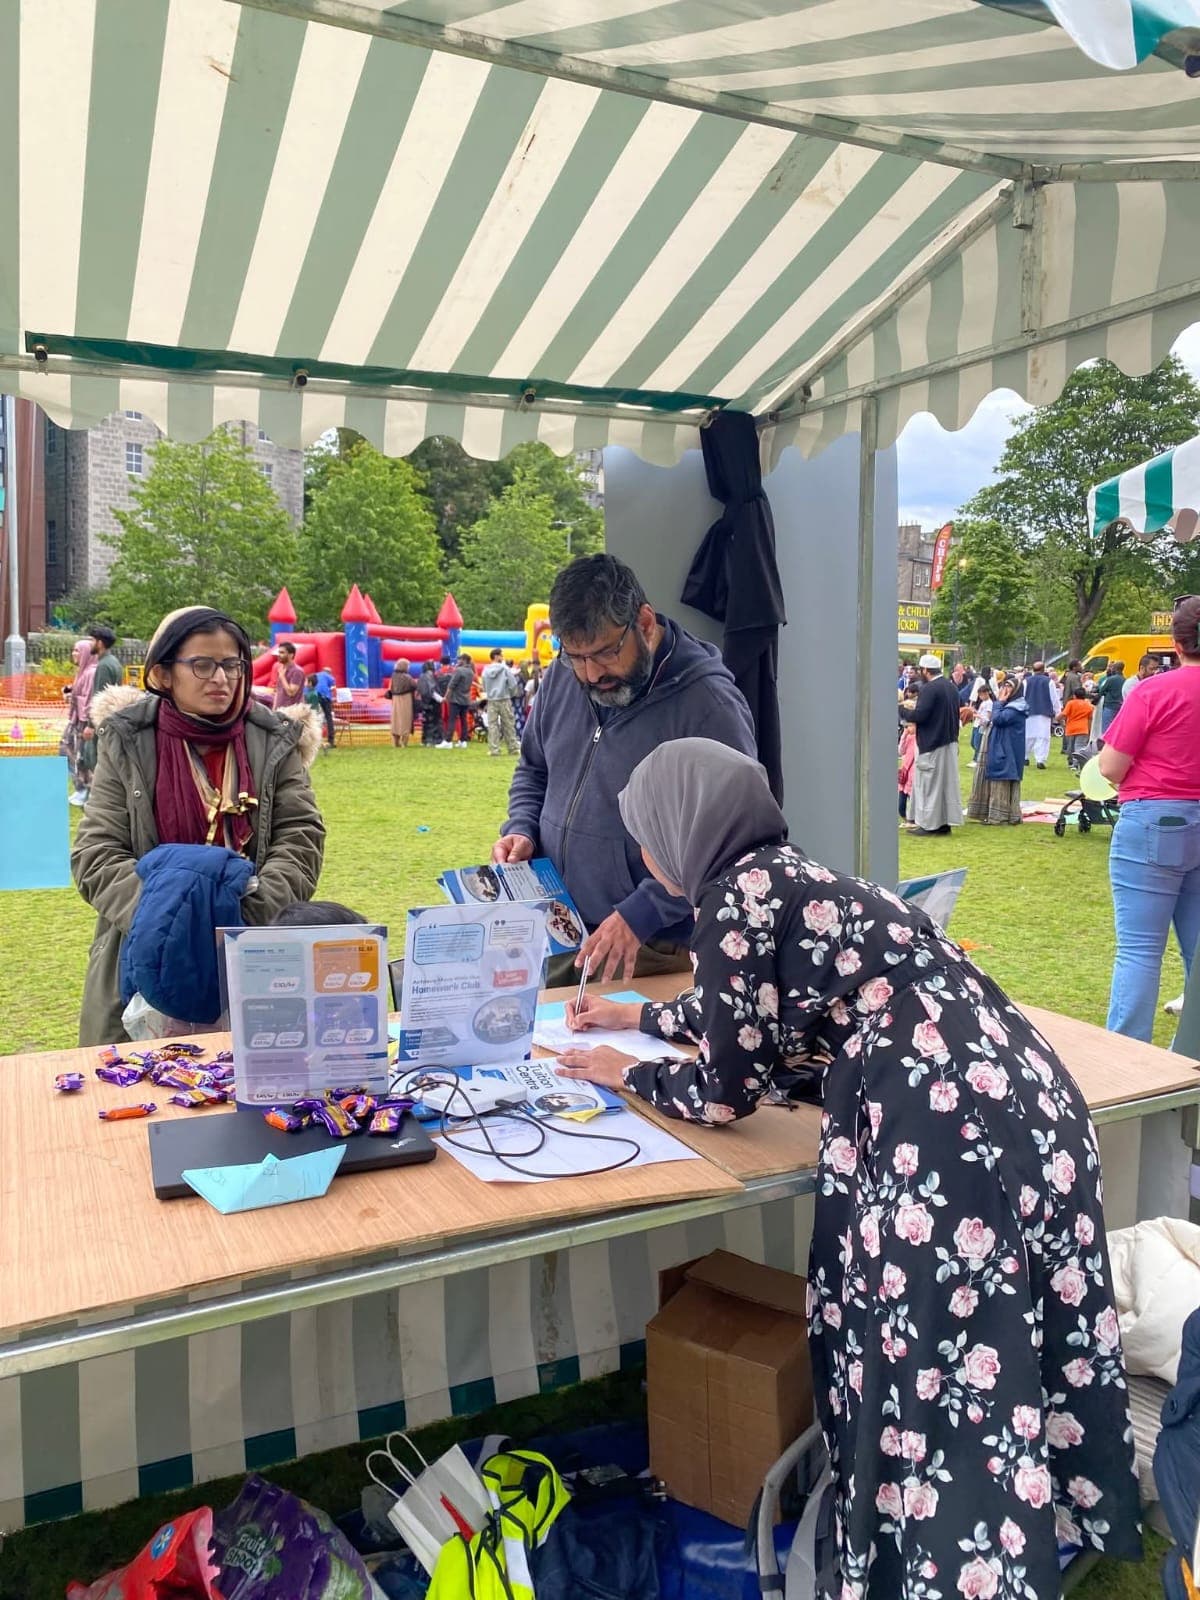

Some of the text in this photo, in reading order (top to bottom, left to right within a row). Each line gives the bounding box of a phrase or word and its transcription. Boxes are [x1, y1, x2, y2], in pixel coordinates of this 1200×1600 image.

[935, 539, 946, 582] CHIPS
[411, 980, 481, 995] Homework Club
[515, 1064, 540, 1091] Centre
[529, 1063, 554, 1089] Tuition
[238, 1533, 267, 1555] Fruit
